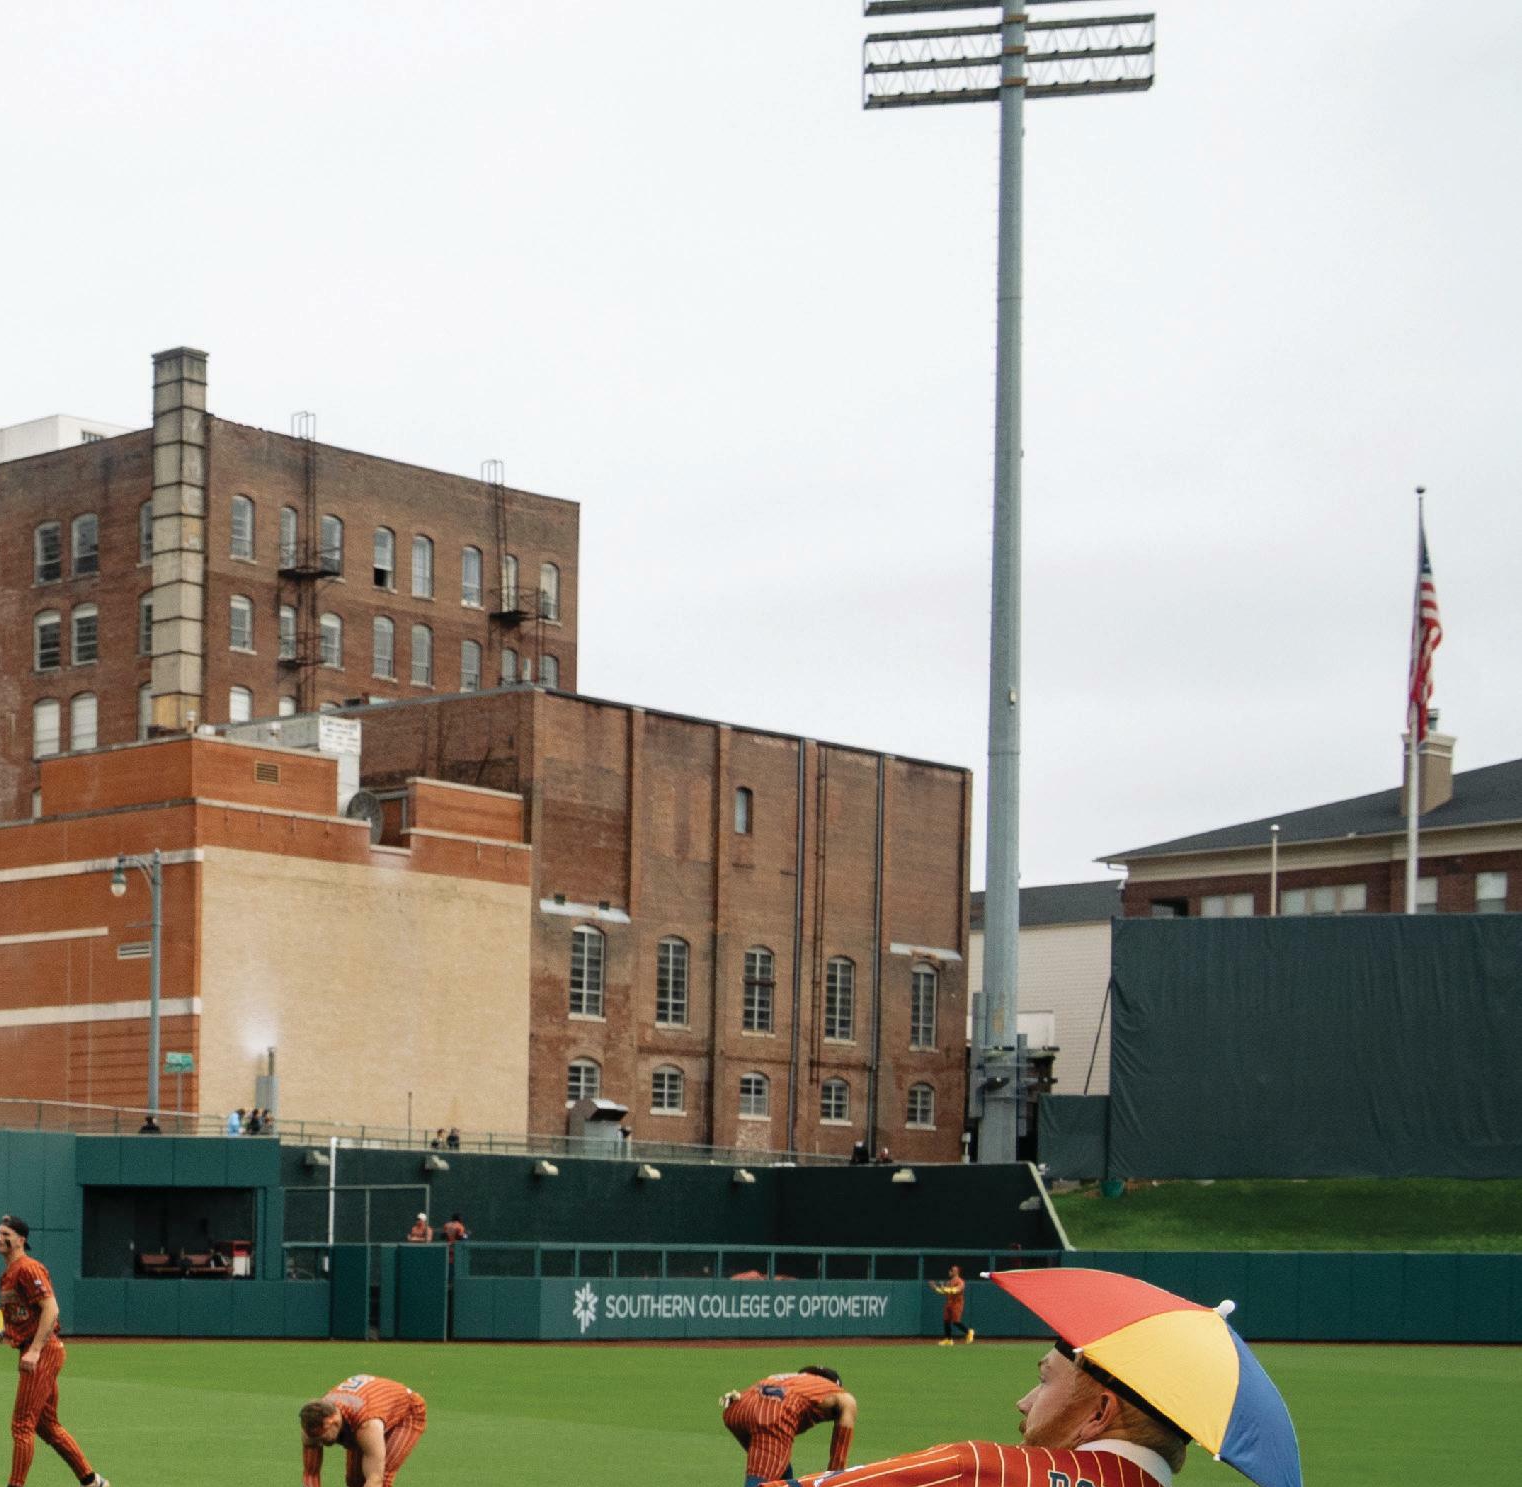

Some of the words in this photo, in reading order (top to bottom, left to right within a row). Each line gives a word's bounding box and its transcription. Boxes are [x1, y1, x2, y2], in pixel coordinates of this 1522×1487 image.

[605, 1295, 695, 1319] SOUTHERN
[699, 1295, 771, 1319] COLLEGE
[774, 1295, 796, 1318] OF
[799, 1295, 889, 1319] OPTOMETRY
